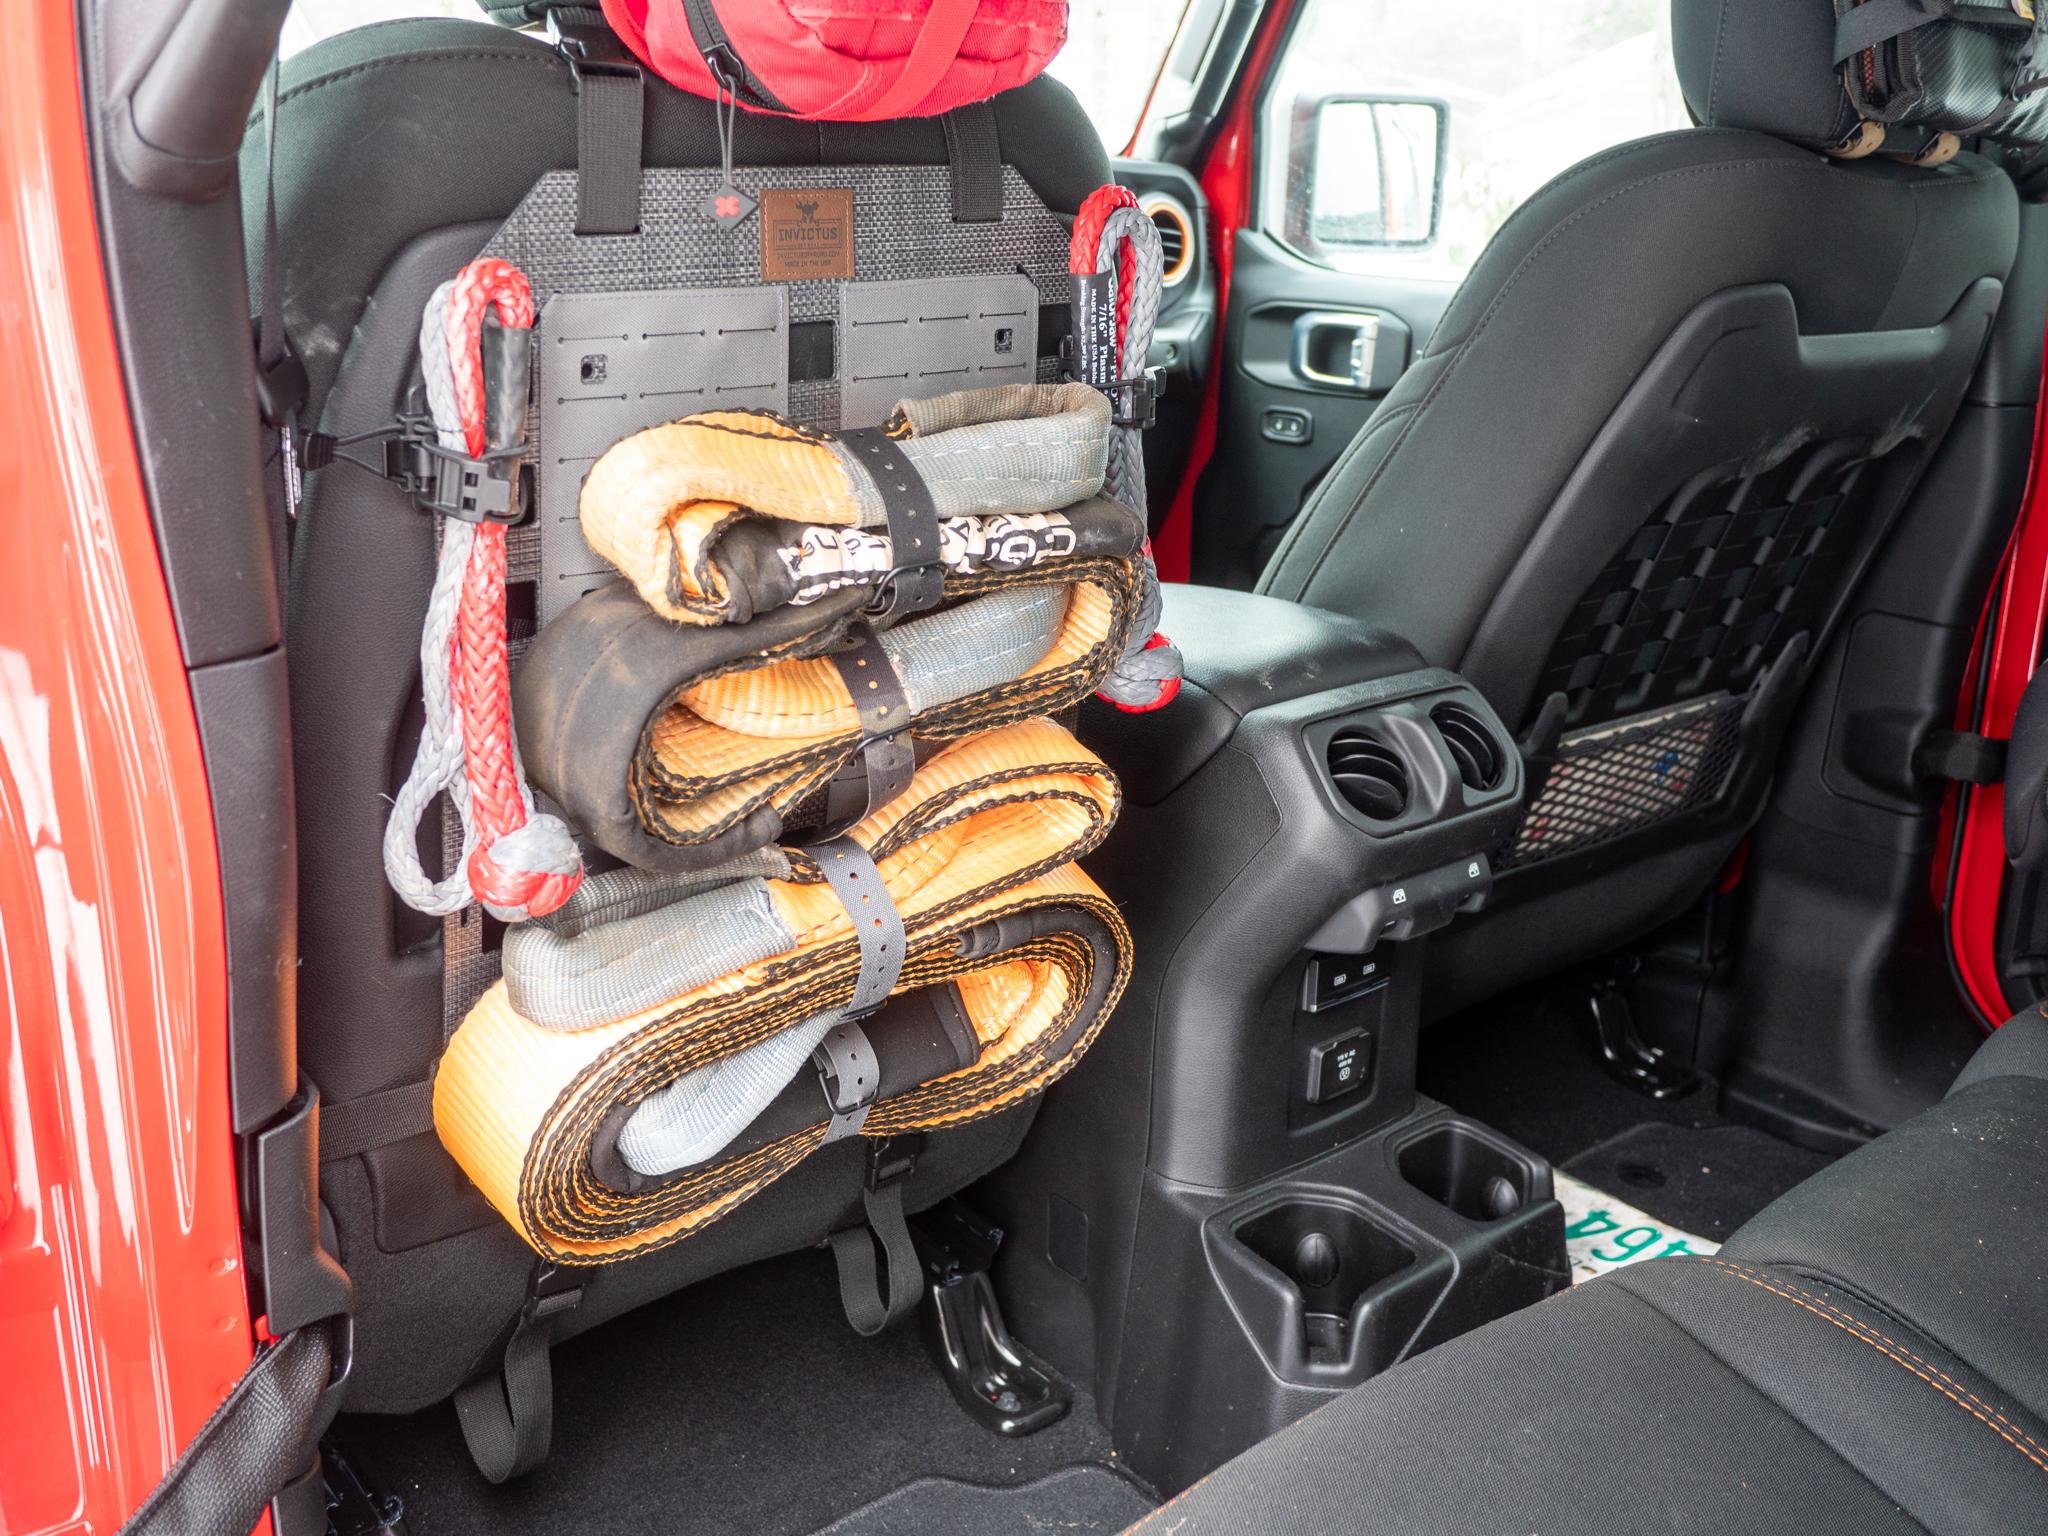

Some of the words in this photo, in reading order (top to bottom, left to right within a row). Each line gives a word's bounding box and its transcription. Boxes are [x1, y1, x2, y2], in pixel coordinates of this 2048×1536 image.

[778, 227, 838, 241] INVICTUS
[1079, 279, 1087, 306] Breaking
[1090, 314, 1097, 324] IN
